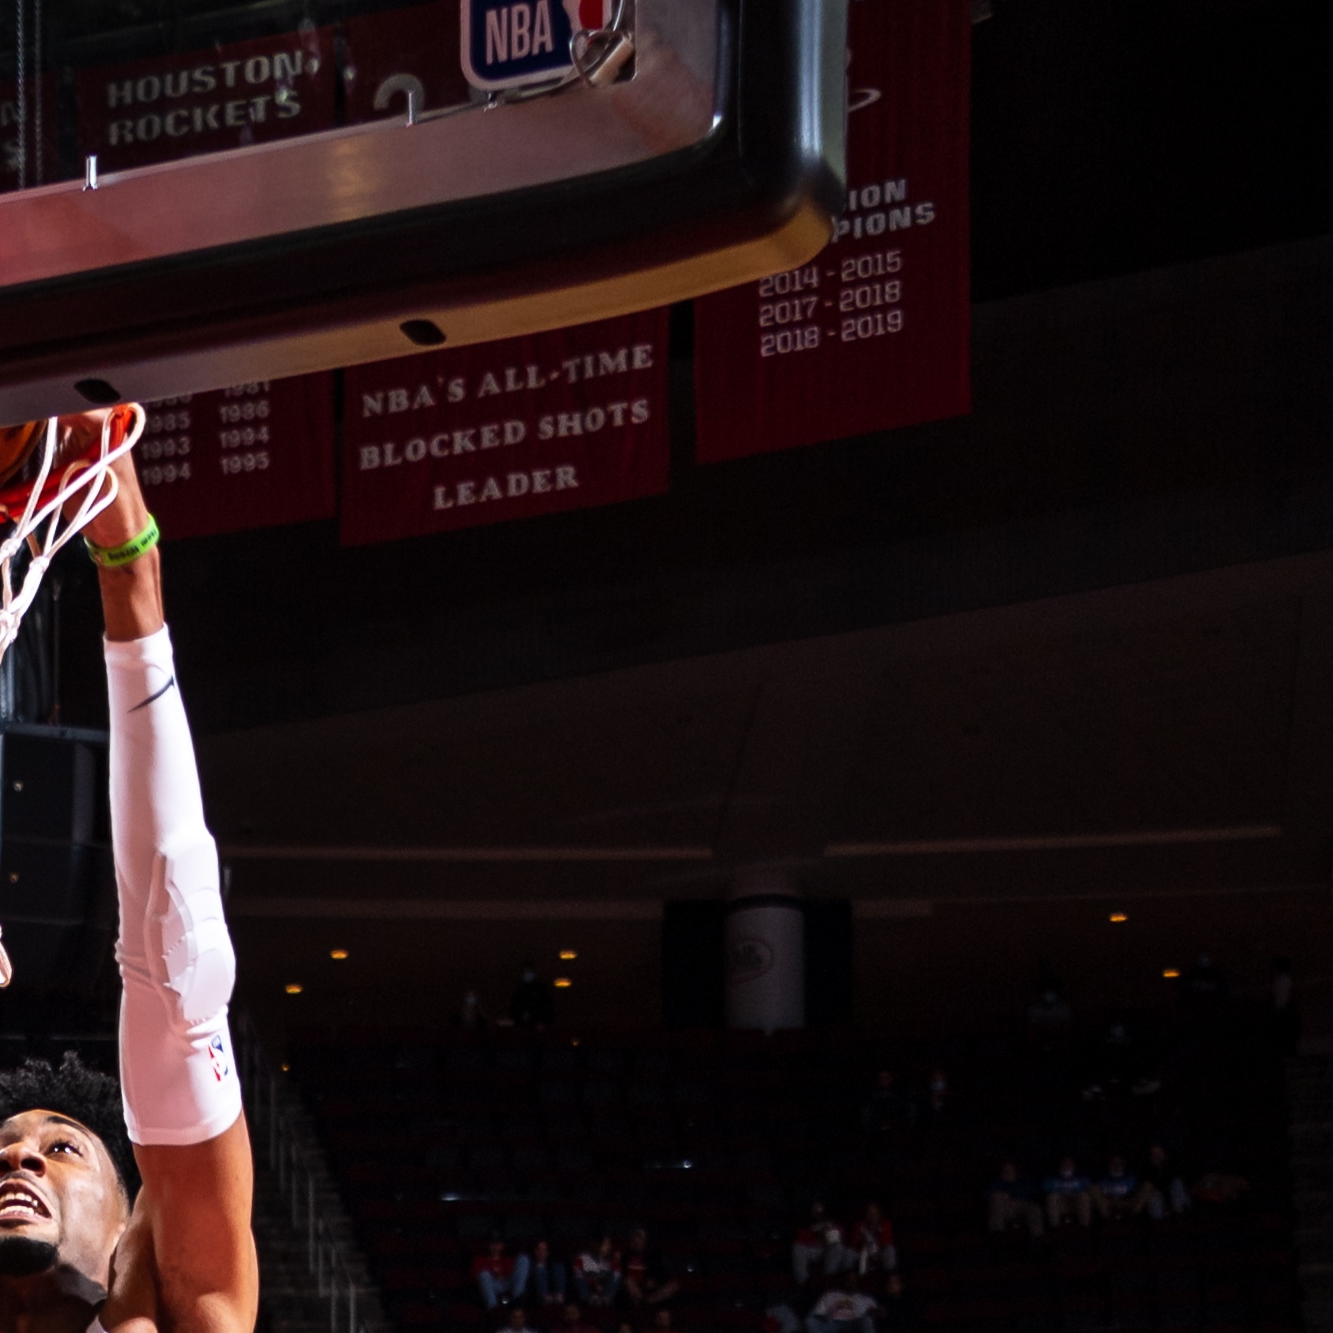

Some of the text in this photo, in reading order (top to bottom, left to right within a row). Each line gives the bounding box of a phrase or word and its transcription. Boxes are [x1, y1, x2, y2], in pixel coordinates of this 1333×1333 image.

[486, 0, 553, 65] NBA
[106, 51, 304, 108] HOUSTON
[108, 89, 303, 146] ROCKETS
[759, 265, 820, 298] 2014
[840, 250, 905, 282] 2015
[759, 296, 820, 328] 2017
[839, 279, 903, 312] 2018
[760, 325, 821, 358] 2018
[840, 308, 905, 342] 2019
[361, 343, 655, 419] NBA'S ALL-TIME
[359, 397, 652, 471] BLOCKED SHOTS
[431, 464, 580, 511] LEADER
